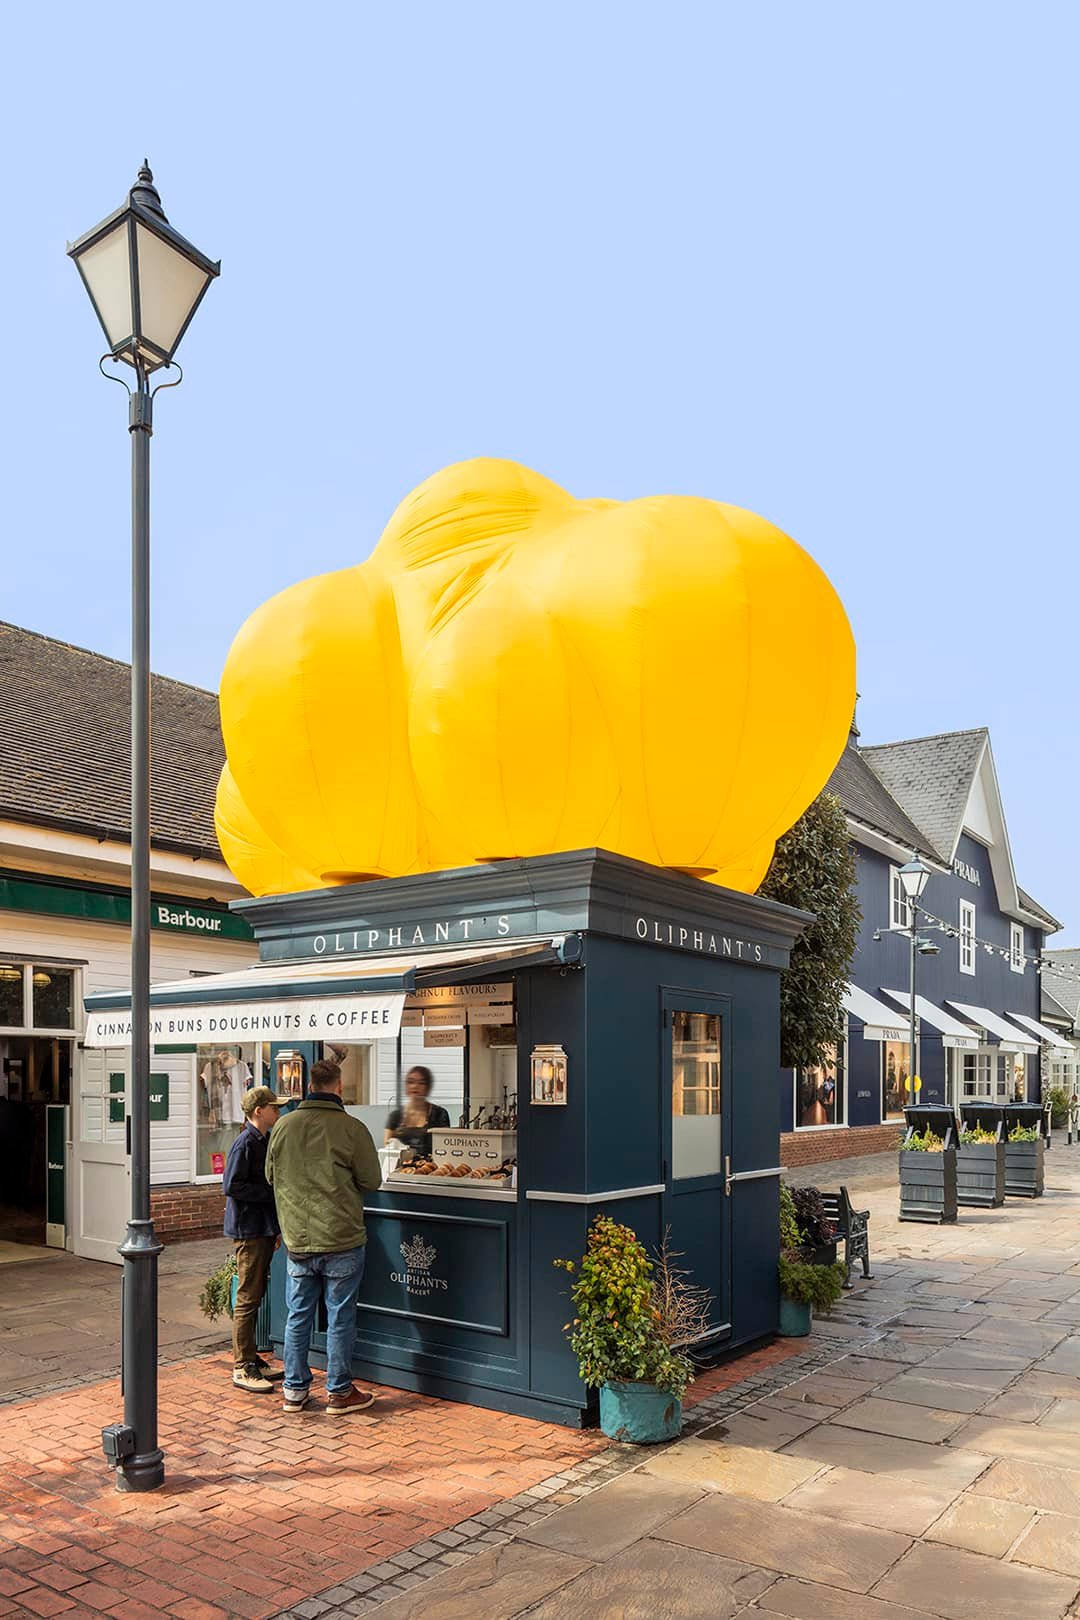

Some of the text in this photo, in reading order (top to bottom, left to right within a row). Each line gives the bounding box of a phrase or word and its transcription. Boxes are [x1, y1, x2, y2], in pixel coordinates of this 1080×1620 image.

[953, 858, 981, 887] PRADA
[158, 906, 221, 931] Barbour
[313, 915, 511, 954] OLIPHANT'S
[636, 918, 762, 962] OLIPHANT'S
[449, 983, 497, 996] FLAVOURS
[97, 1021, 162, 1036] CINNAN
[168, 1019, 203, 1033] BUNS
[209, 1014, 301, 1031] DOUGHNUTS
[308, 1014, 318, 1028] &
[326, 1009, 390, 1026] COFFEE
[443, 1137, 490, 1148] OLIPHANT'S
